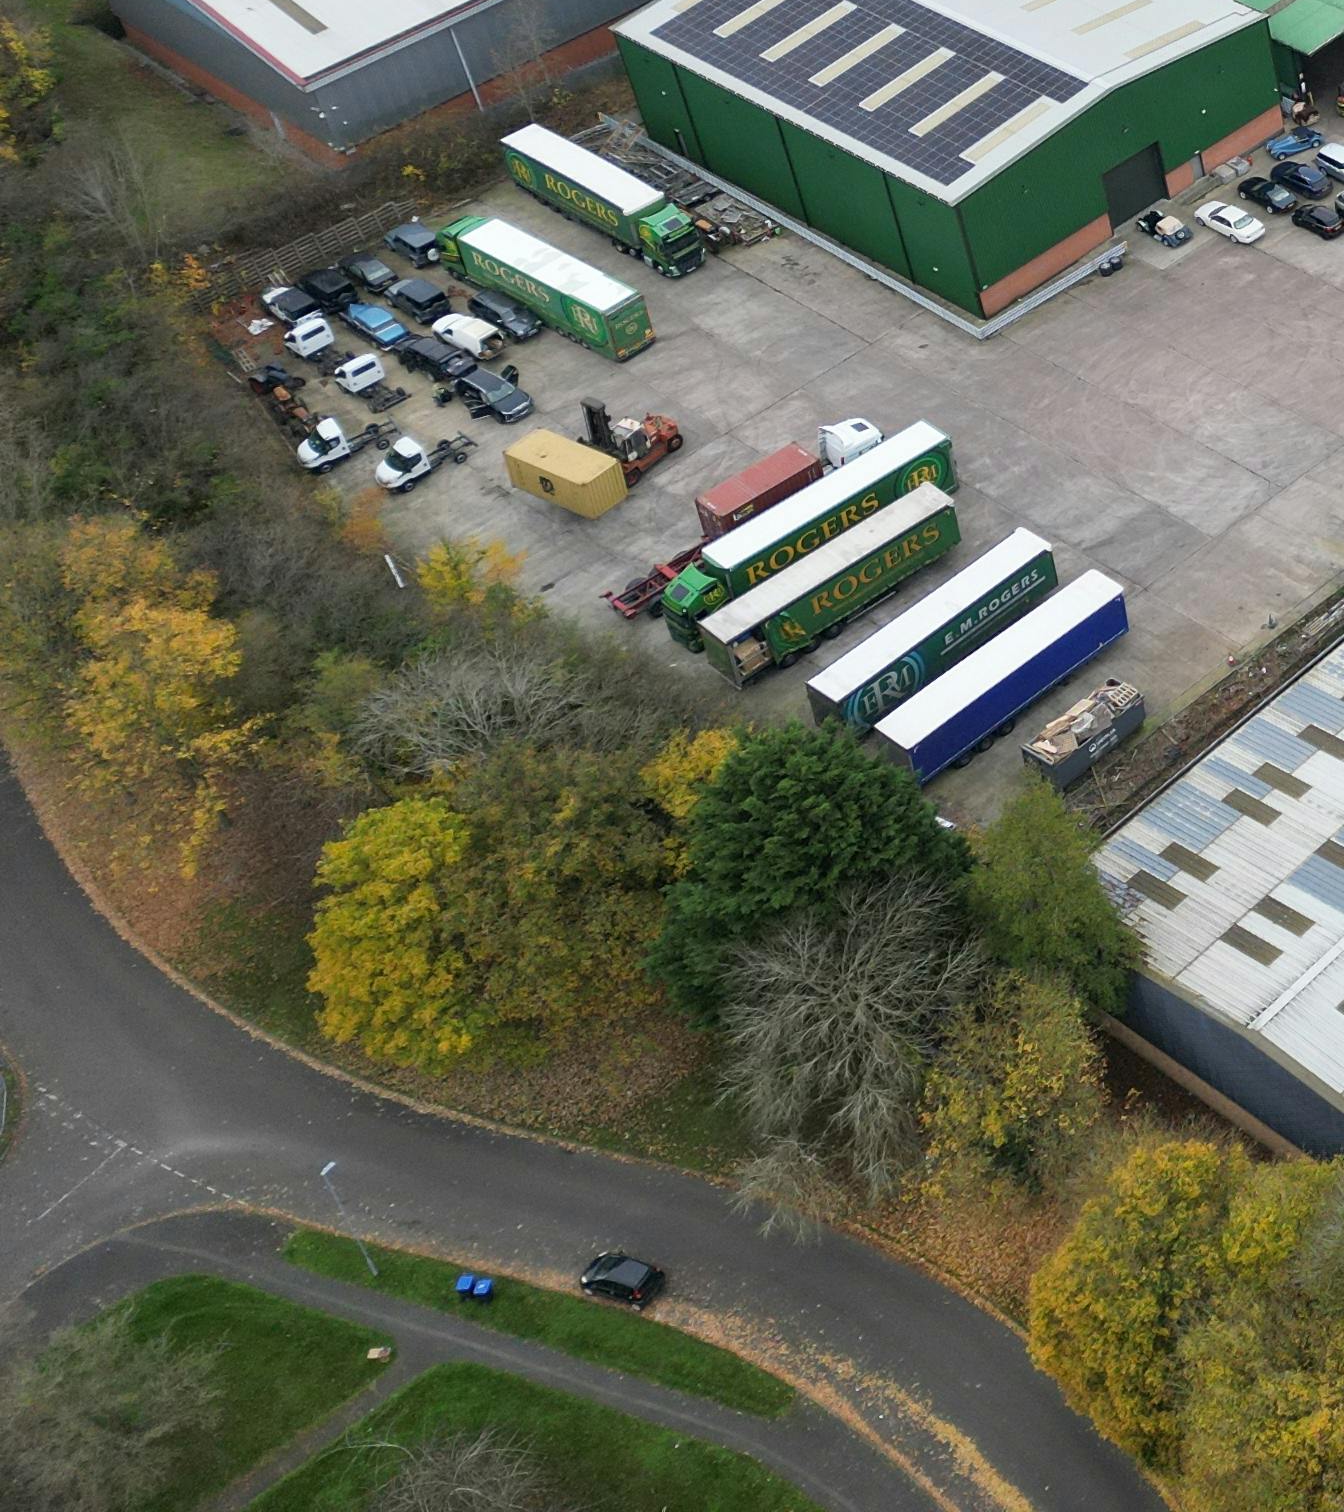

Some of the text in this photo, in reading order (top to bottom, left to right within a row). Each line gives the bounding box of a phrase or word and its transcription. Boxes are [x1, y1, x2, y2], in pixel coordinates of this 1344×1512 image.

[543, 171, 619, 228] ROGERS
[471, 250, 550, 303] ROGERS
[745, 491, 881, 586] ROGERS
[809, 521, 941, 617] ROGERS
